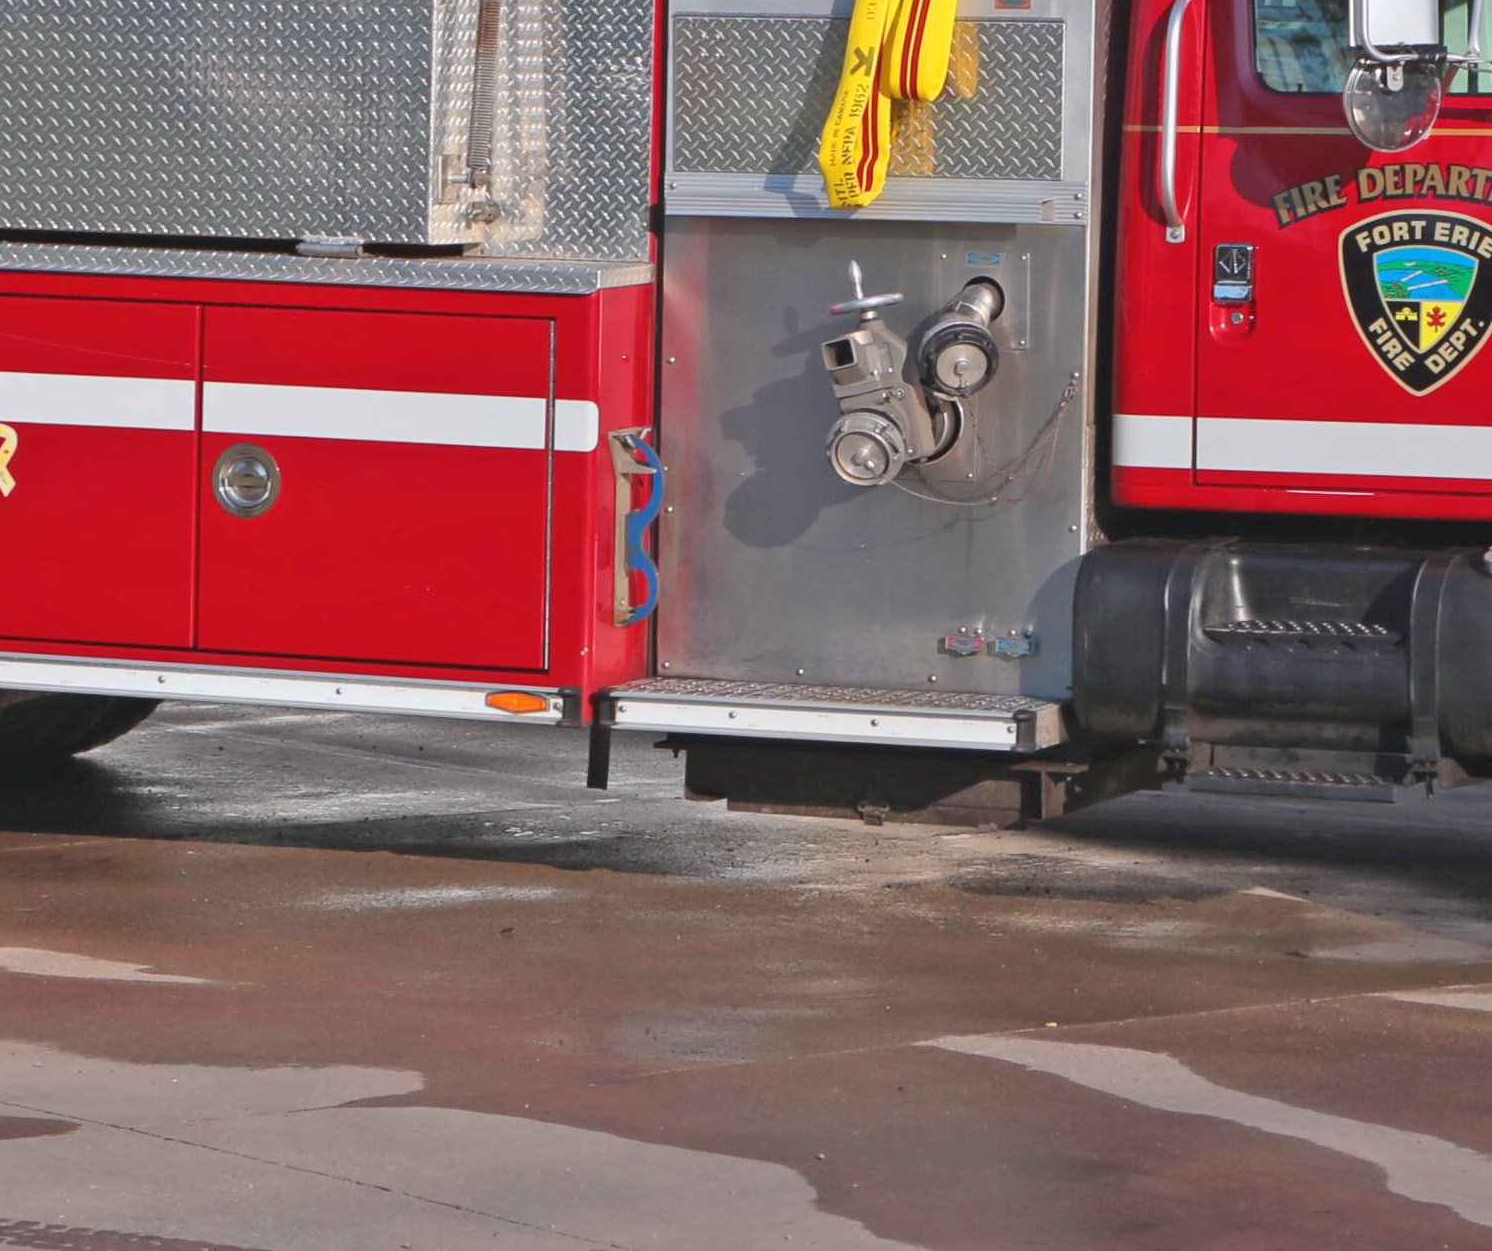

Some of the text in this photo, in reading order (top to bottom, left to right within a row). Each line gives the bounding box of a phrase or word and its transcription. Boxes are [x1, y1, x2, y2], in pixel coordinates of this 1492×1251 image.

[841, 126, 856, 165] NFPA
[849, 84, 869, 117] 1962
[1270, 174, 1348, 229] FIRE
[1354, 219, 1428, 254] FORT
[1368, 317, 1485, 375] FIRE DEPT.
